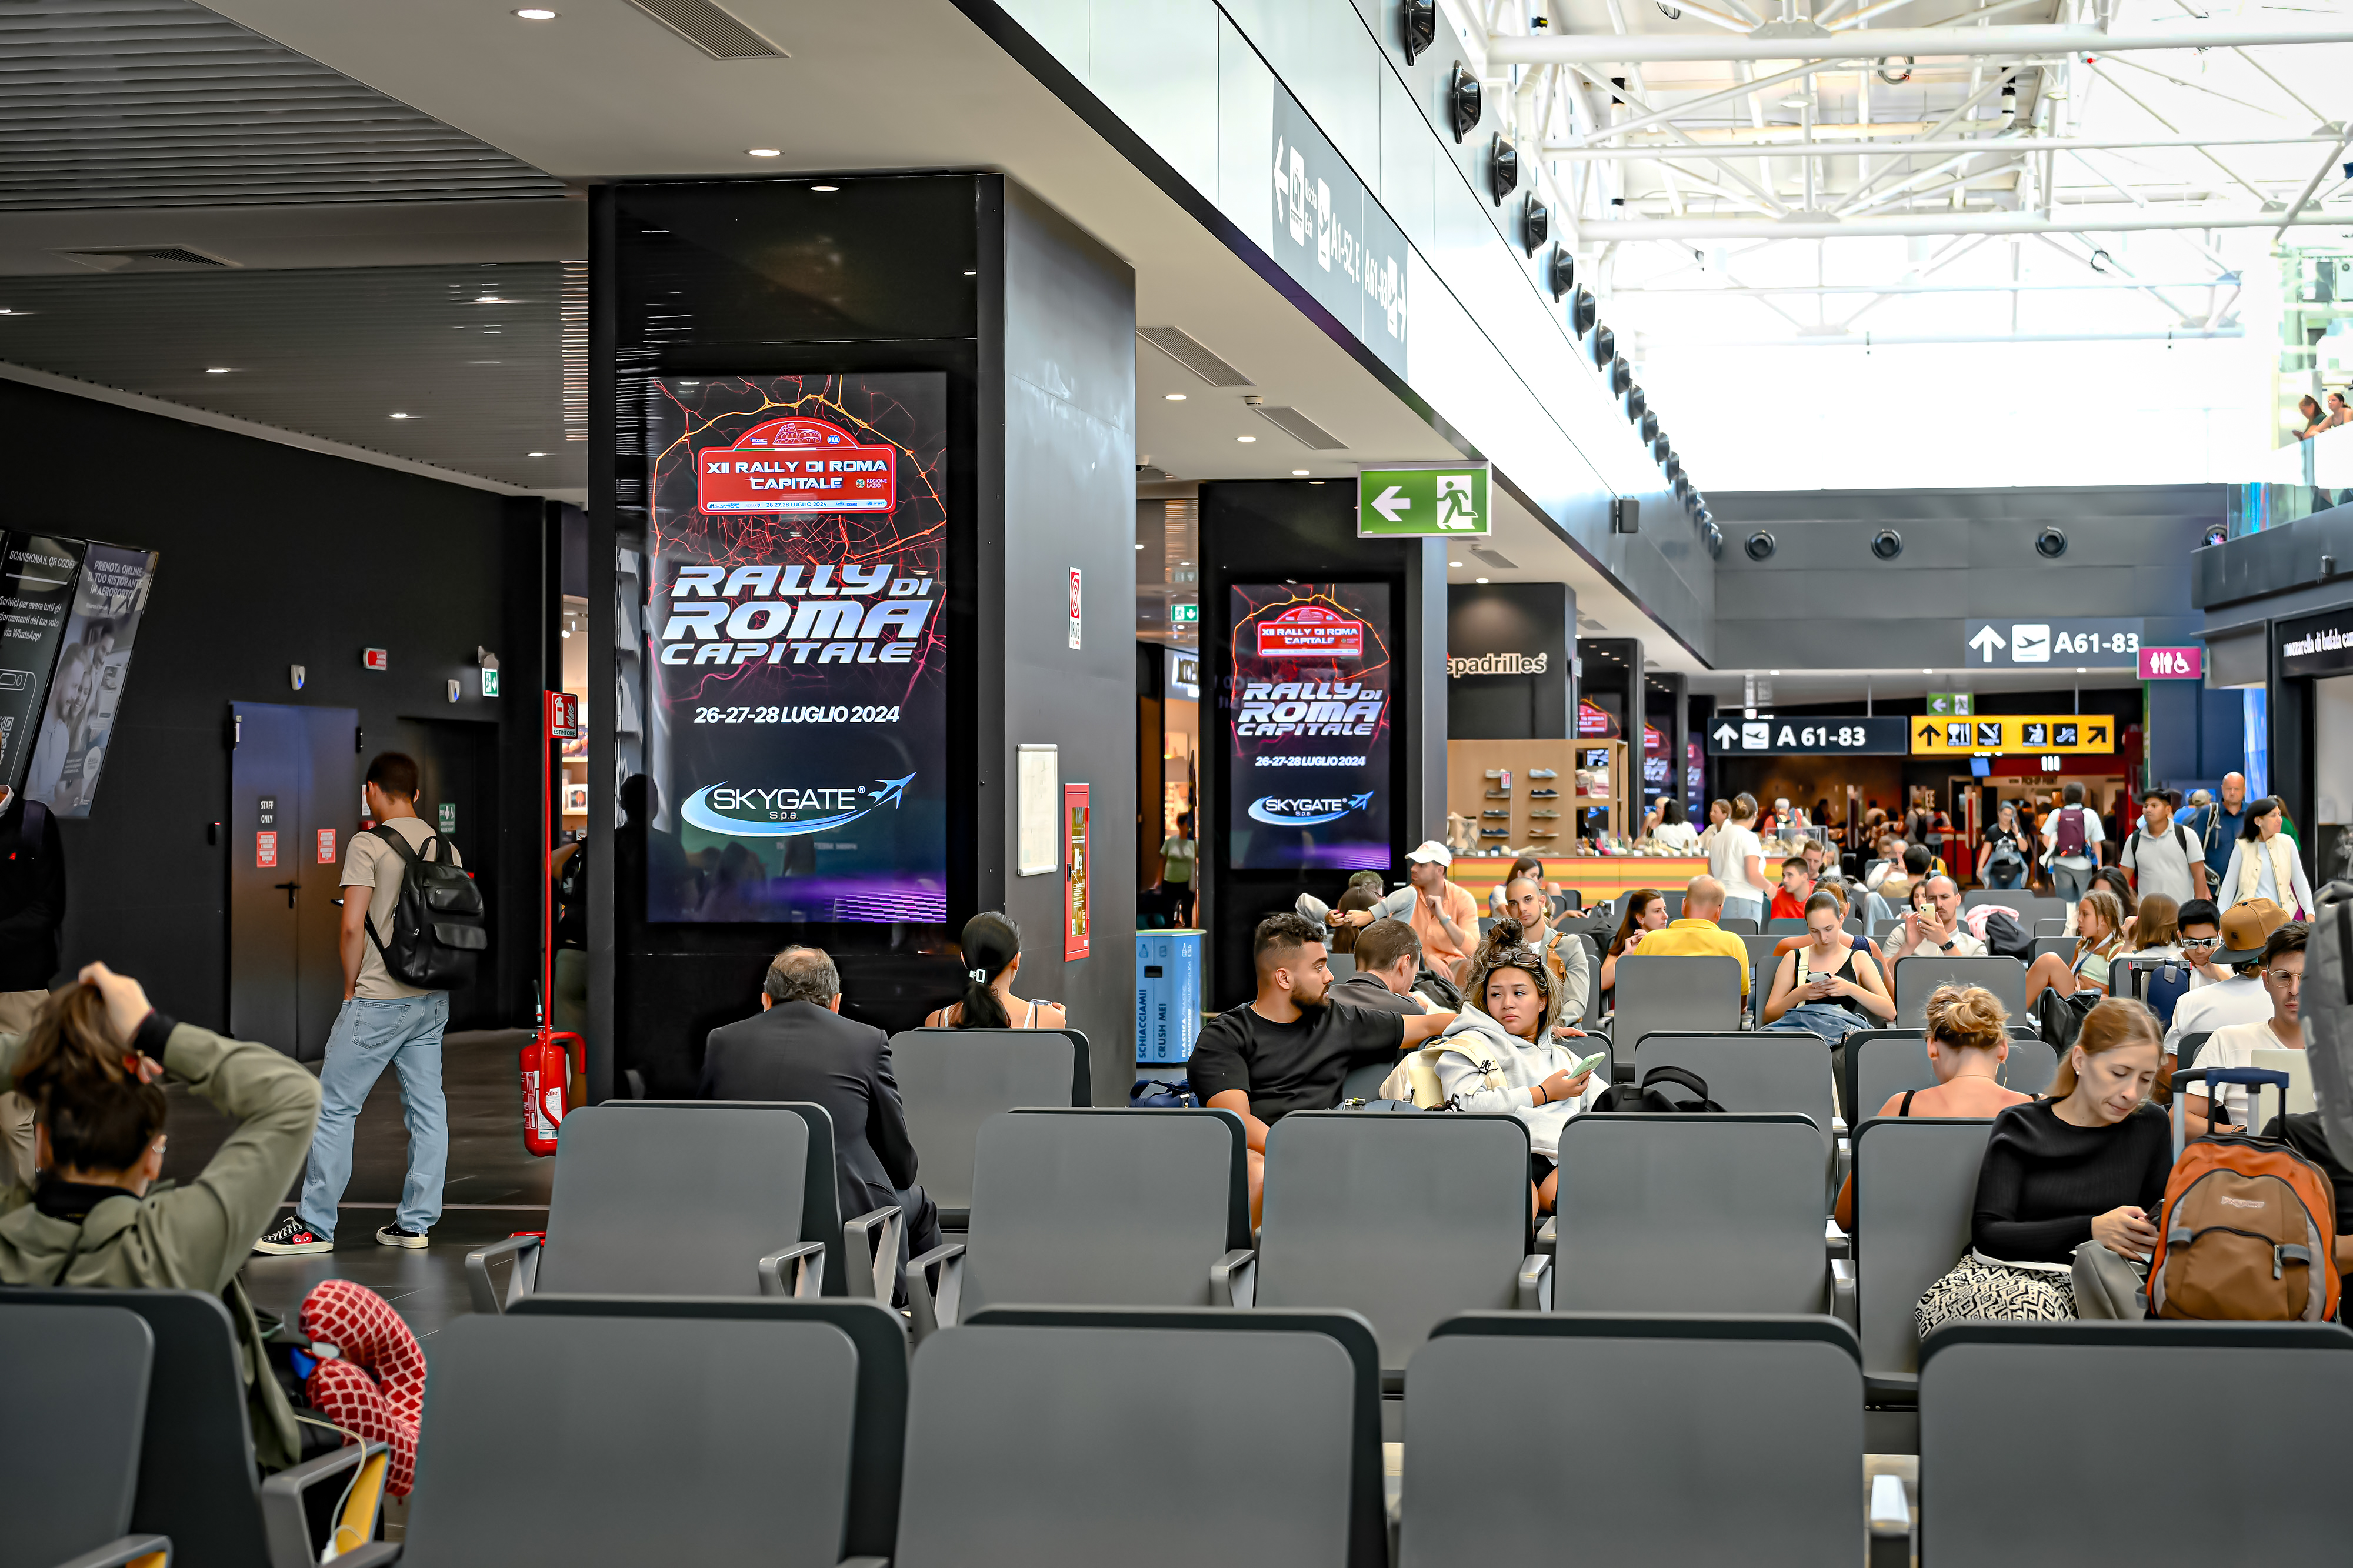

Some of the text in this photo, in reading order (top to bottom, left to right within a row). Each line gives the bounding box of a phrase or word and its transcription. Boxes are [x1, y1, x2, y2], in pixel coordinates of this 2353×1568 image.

[1305, 178, 1317, 210] Uscita
[1364, 249, 1387, 311] A61-83
[706, 460, 888, 473] XII RALLY DI ROMA
[751, 477, 843, 490] CAPITALE
[48, 558, 57, 568] QR
[57, 558, 75, 569] CODE!
[94, 560, 144, 577] PRENOTA ONLINE
[95, 573, 107, 584] TUO
[107, 575, 144, 589] RISTORANTE
[670, 564, 934, 598] RALLY DI
[90, 585, 98, 594] IN
[0, 596, 19, 608] Scrivici
[18, 601, 28, 610] per
[28, 602, 43, 610] avere
[44, 603, 55, 612] tutti
[30, 616, 39, 625] del
[39, 618, 48, 626] tuo
[48, 618, 59, 628] volo
[662, 599, 934, 640] ROMA
[12, 628, 42, 642] WhatsApp!
[2054, 632, 2139, 653] A61-83
[660, 642, 917, 665] CAPITALE
[1242, 682, 1382, 700] RALLY DI
[694, 706, 900, 723] 26-27-28 LUGLIO 2024
[1238, 701, 1382, 723] ROMA
[1237, 723, 1374, 736] CAPITALE
[1777, 725, 1866, 747] A 61-83
[1255, 756, 1366, 767] 26-27-28 LUGLIO 2024
[261, 800, 274, 810] STAFF
[713, 787, 856, 810] SKYGATE
[1265, 799, 1343, 812] SKYGATE
[261, 815, 274, 823] ONLY
[1158, 1025, 1166, 1059] CRUSH
